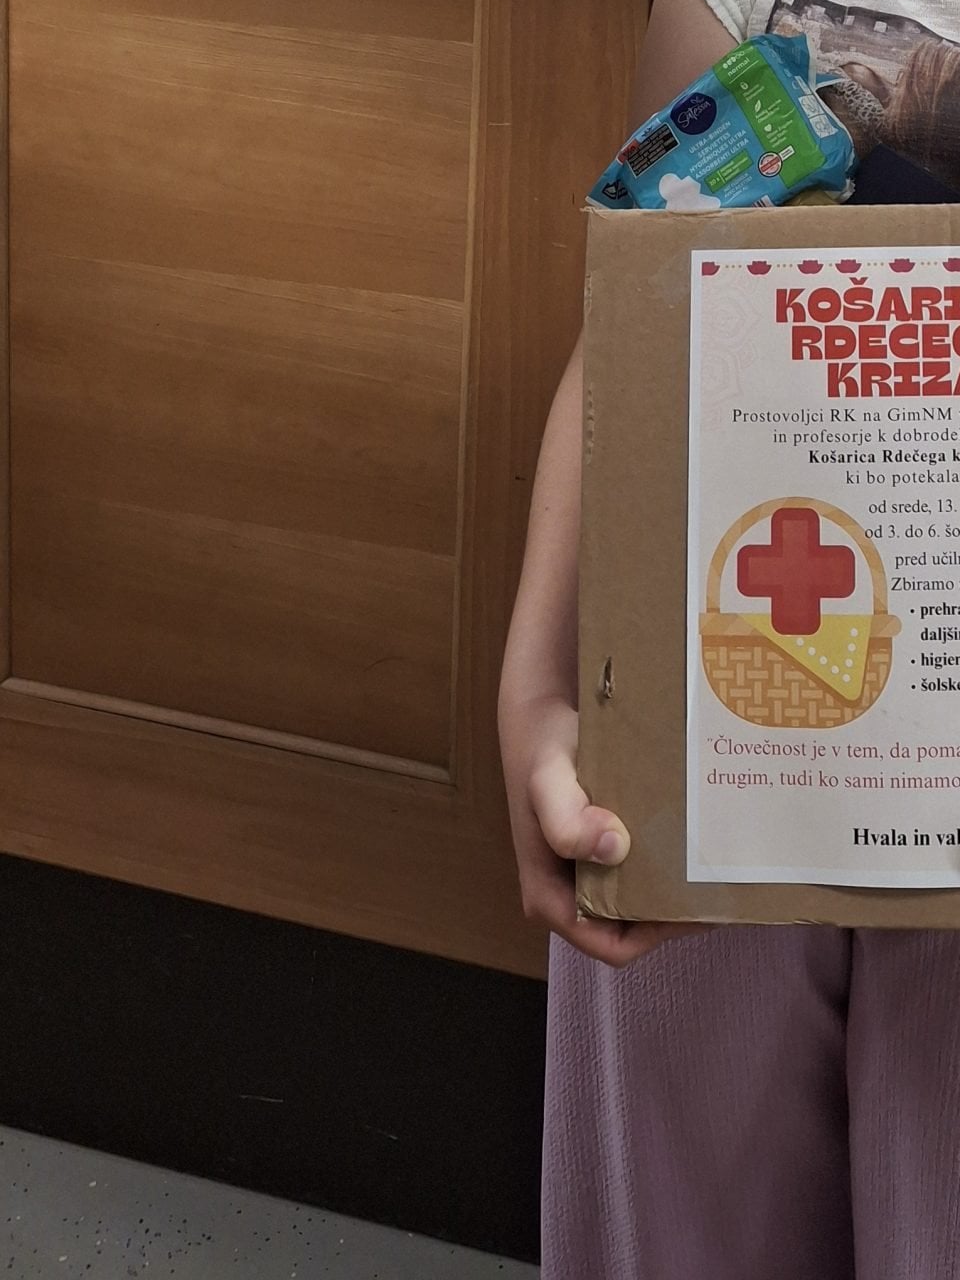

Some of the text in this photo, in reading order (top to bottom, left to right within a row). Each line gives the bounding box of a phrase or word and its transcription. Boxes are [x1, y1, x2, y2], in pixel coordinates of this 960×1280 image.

[727, 58, 750, 77] normal
[678, 101, 711, 128] Satessa
[688, 121, 731, 154] ULTRA-BINDEN
[697, 132, 731, 158] SERVIETTES
[728, 129, 747, 145] ULTRA
[695, 150, 730, 179] ASSORBENTI
[730, 138, 750, 154] ULTRA
[733, 409, 823, 425] Prostovoljci
[831, 409, 856, 422] RK
[864, 412, 880, 421] na
[888, 408, 952, 421] GimNM
[774, 434, 786, 442] in
[794, 429, 871, 446] profesorje
[879, 429, 886, 442] k
[809, 450, 875, 463] Košarica
[883, 449, 945, 465] Rdečega
[846, 470, 959, 487] ki bo potekala
[869, 500, 886, 513] od
[892, 499, 932, 517] srede,
[938, 499, 957, 512] 13.
[865, 525, 883, 539] od
[888, 525, 900, 538] 3.
[905, 524, 923, 538] do
[928, 524, 940, 538] 6.
[896, 552, 926, 569] pred
[891, 577, 954, 591] Zbiramo
[811, 742, 826, 761] je
[832, 746, 840, 757] v
[847, 744, 883, 760] tem,
[890, 742, 911, 758] da
[707, 768, 773, 789] drugim,
[780, 770, 812, 786] tudi
[819, 770, 838, 787] ko
[845, 772, 884, 788] sami
[890, 772, 960, 788] nimamo
[853, 828, 907, 846] Hvala
[914, 829, 930, 846] in
